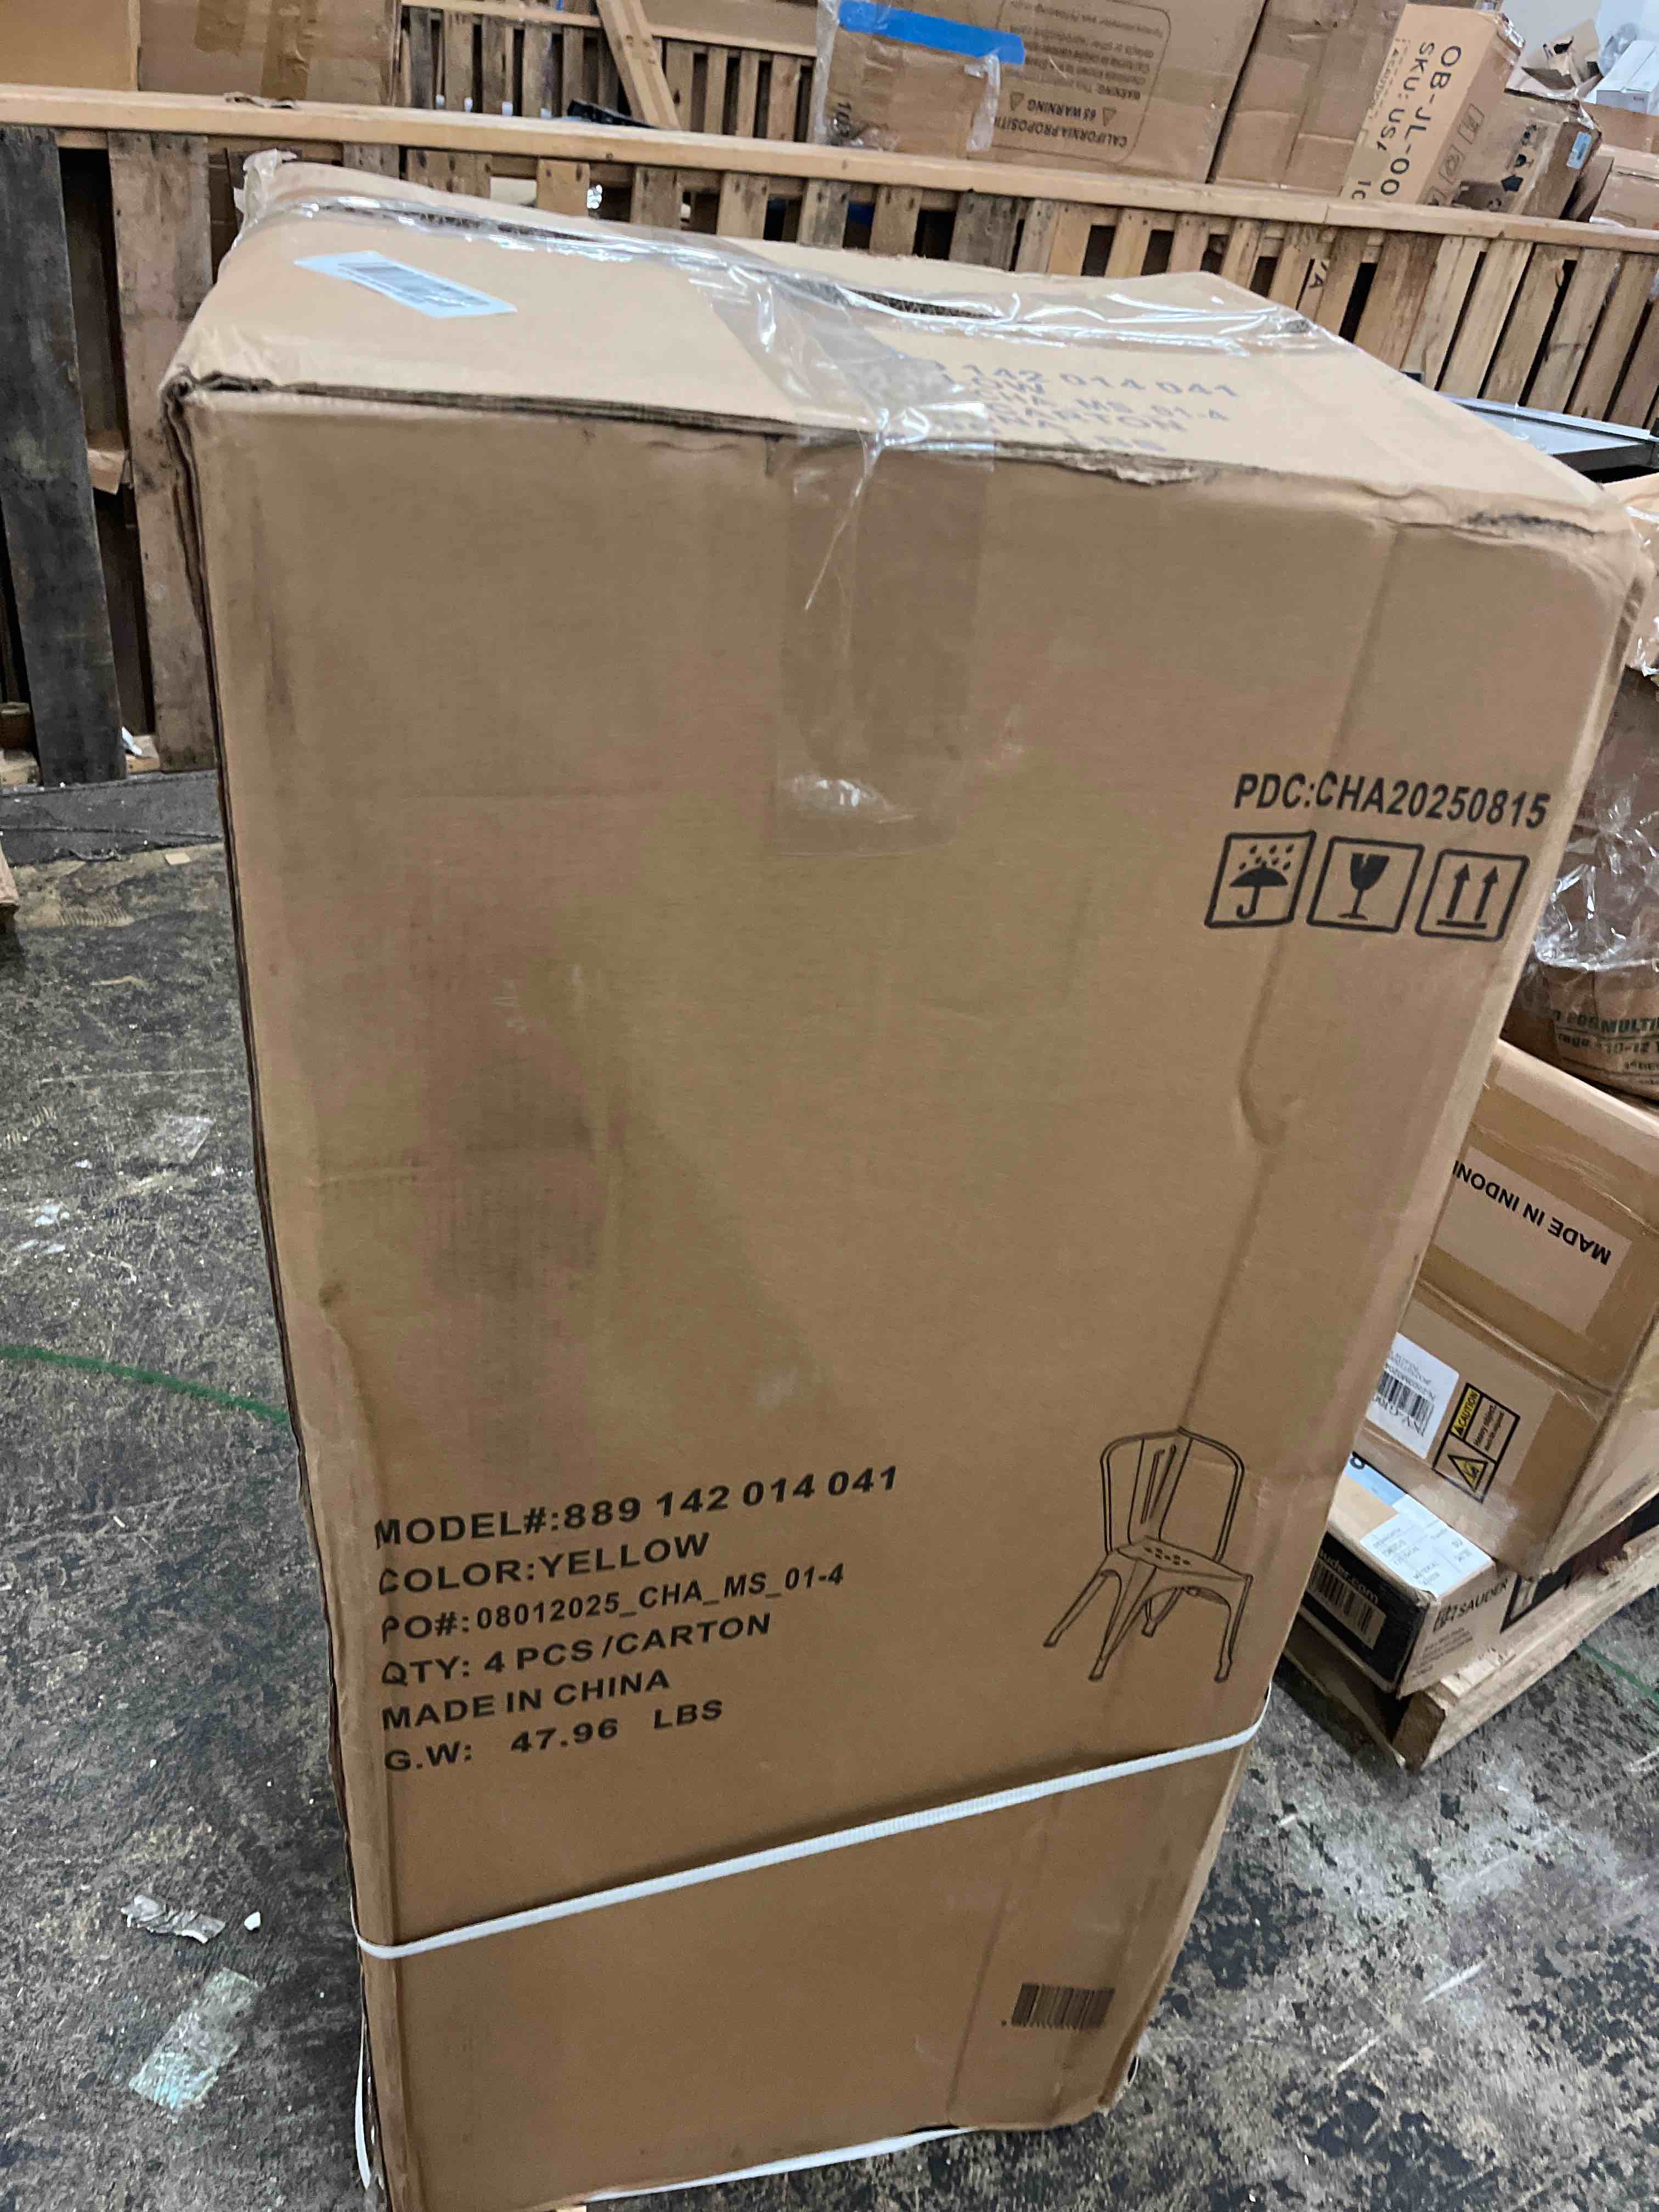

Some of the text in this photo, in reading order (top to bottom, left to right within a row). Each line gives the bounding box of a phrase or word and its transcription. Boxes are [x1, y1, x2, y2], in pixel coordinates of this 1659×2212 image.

[1234, 771, 1550, 829] PDC:CHA20250815
[1522, 1202, 1545, 1227] IN
[1547, 1216, 1612, 1266] MADE
[1457, 1389, 1479, 1427] CAUTION
[656, 1485, 730, 1518] 142
[742, 1473, 815, 1507] 014
[827, 1465, 896, 1497] 041
[379, 1532, 710, 1595] COLOR:YELLOW
[381, 1655, 470, 1686] QTY:
[484, 1650, 505, 1673] 4
[382, 1668, 670, 1731] MADE IN CHINA
[383, 1699, 723, 1772] G.W: 47.96 LBS
